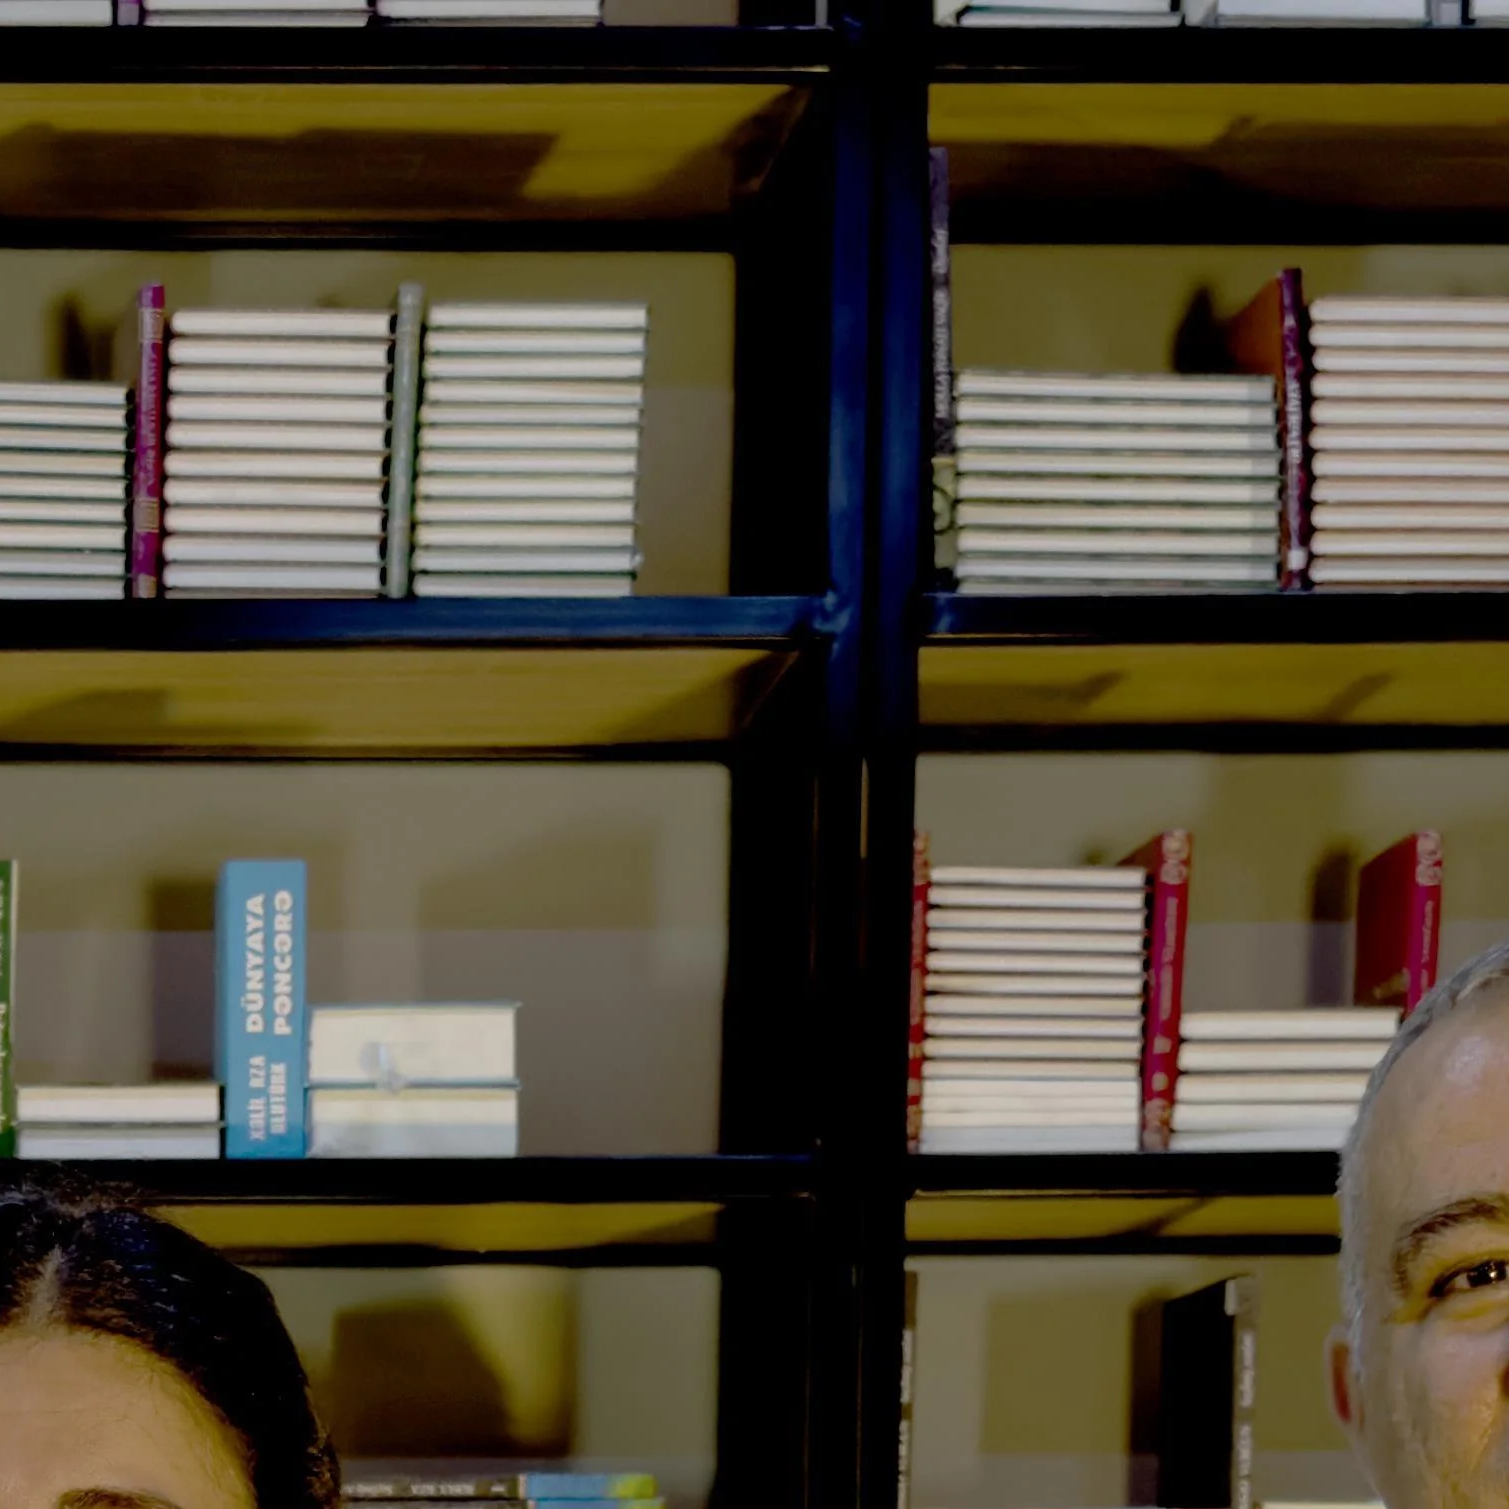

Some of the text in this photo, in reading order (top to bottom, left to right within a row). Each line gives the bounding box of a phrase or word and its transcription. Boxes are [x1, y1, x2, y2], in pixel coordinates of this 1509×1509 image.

[241, 894, 266, 1035] DÜNYAYA
[272, 888, 294, 1037] PƏNCƏRƏ
[247, 1055, 267, 1141] XƏLİL RZA
